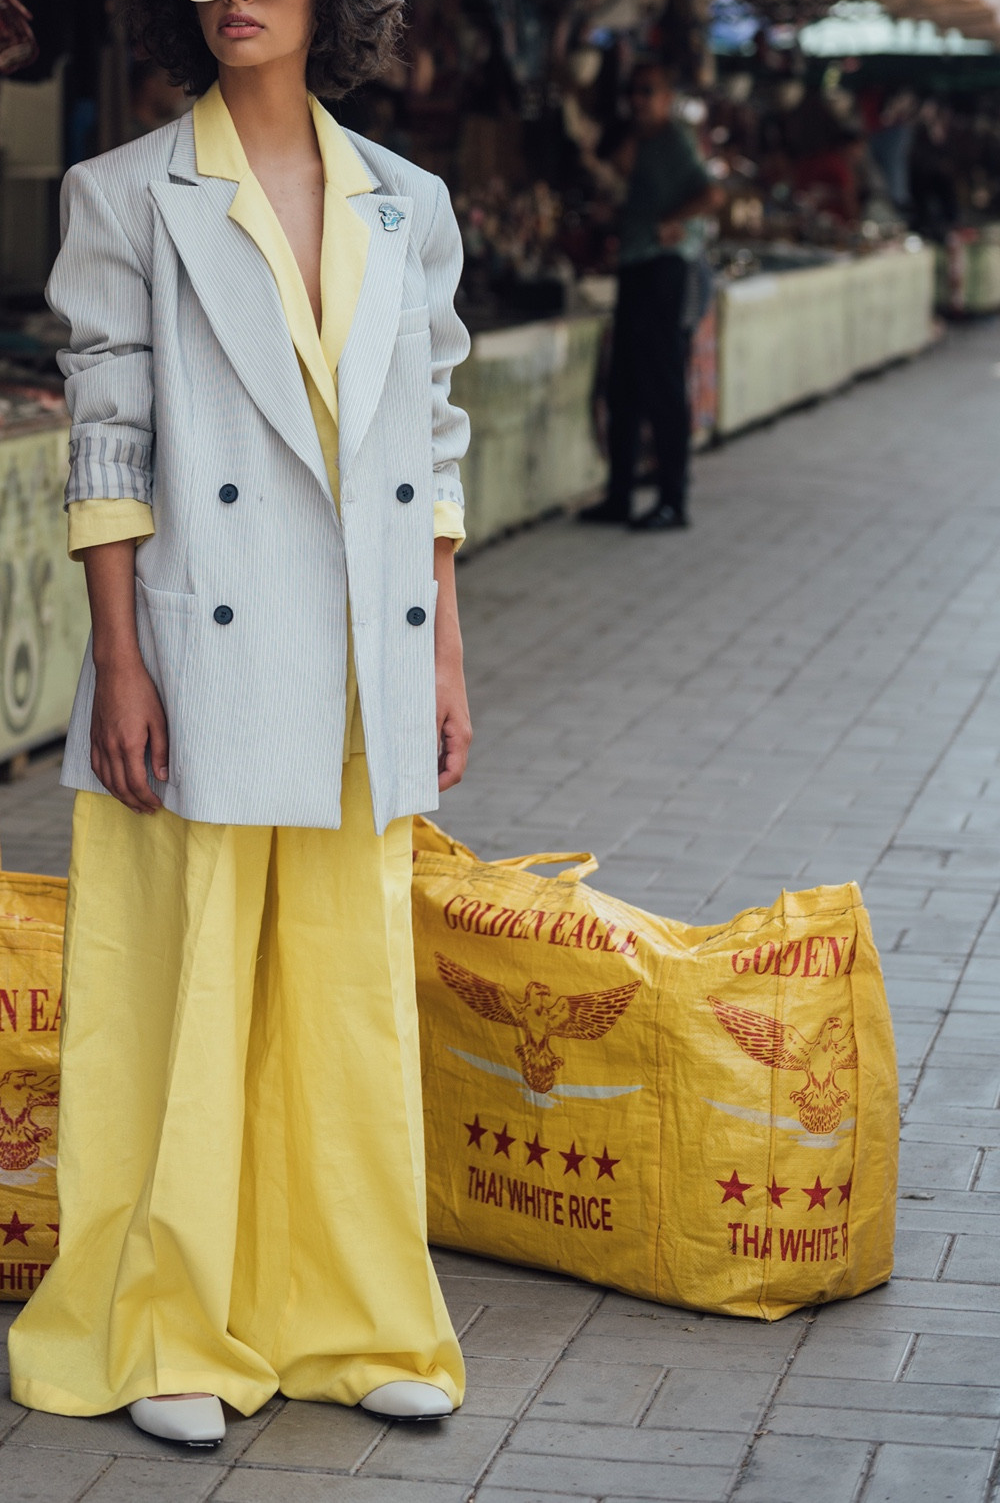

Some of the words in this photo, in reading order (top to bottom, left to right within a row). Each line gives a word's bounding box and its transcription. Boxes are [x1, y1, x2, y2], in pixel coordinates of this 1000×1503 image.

[443, 894, 556, 942] GOLDEN
[547, 911, 640, 959] EAGLE
[468, 1165, 503, 1208] THAI
[507, 1177, 564, 1226] WHITE
[568, 1194, 613, 1232] RICE
[779, 1225, 838, 1262] WHITE
